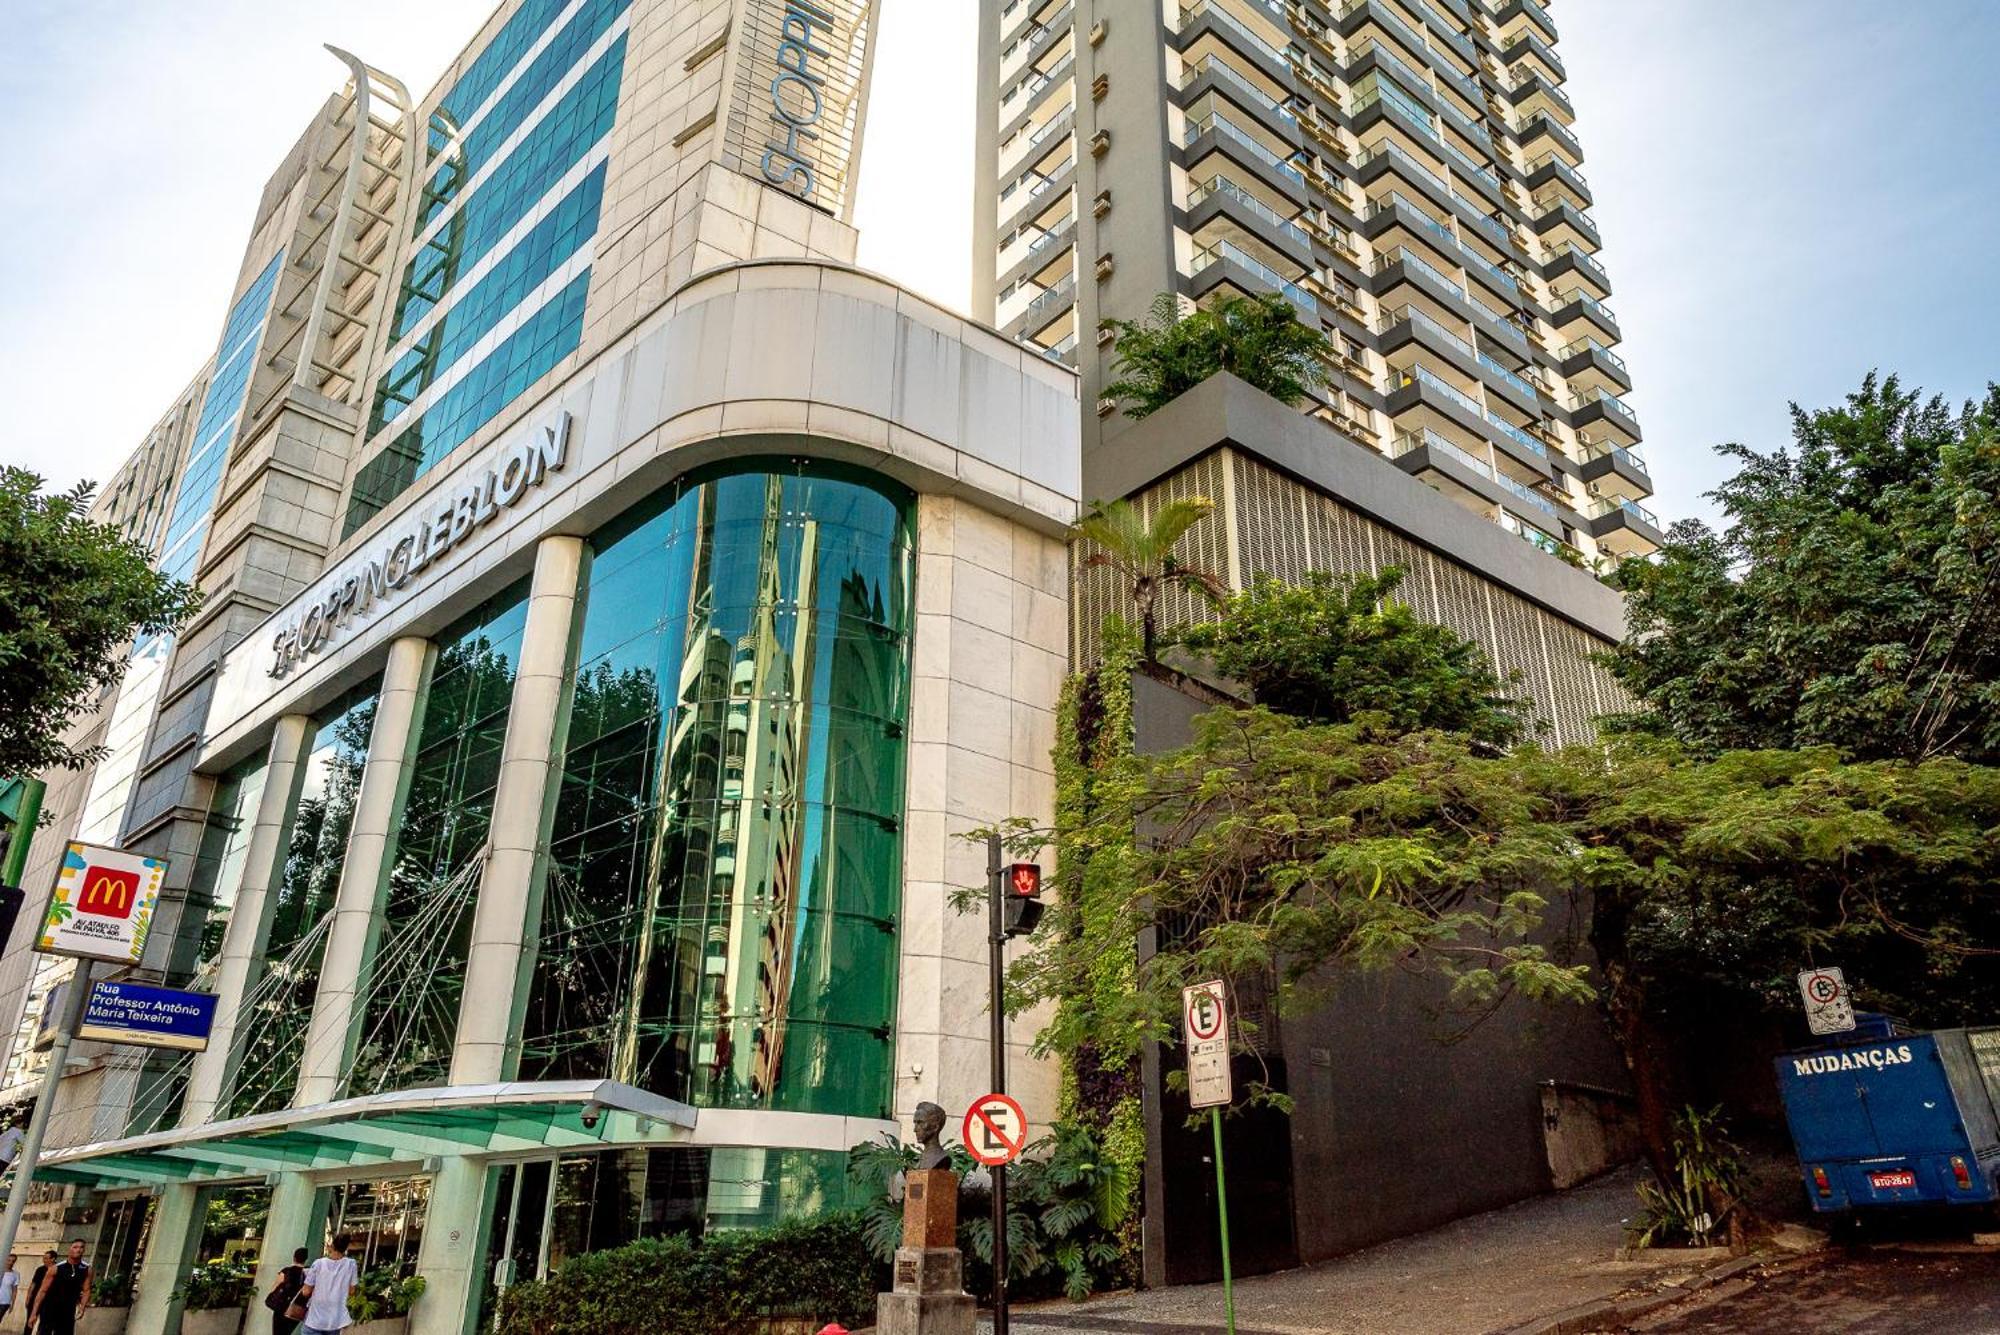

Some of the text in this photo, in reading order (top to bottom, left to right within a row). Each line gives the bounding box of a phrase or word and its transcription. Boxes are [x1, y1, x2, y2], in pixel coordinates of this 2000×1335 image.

[95, 982, 120, 995] Rua
[88, 1005, 126, 1019] Maria
[127, 1008, 173, 1025] Teixeira
[91, 993, 201, 1016] Professor Antônio
[1792, 1044, 1913, 1076] MUDANÇAS
[984, 1109, 1008, 1150] E
